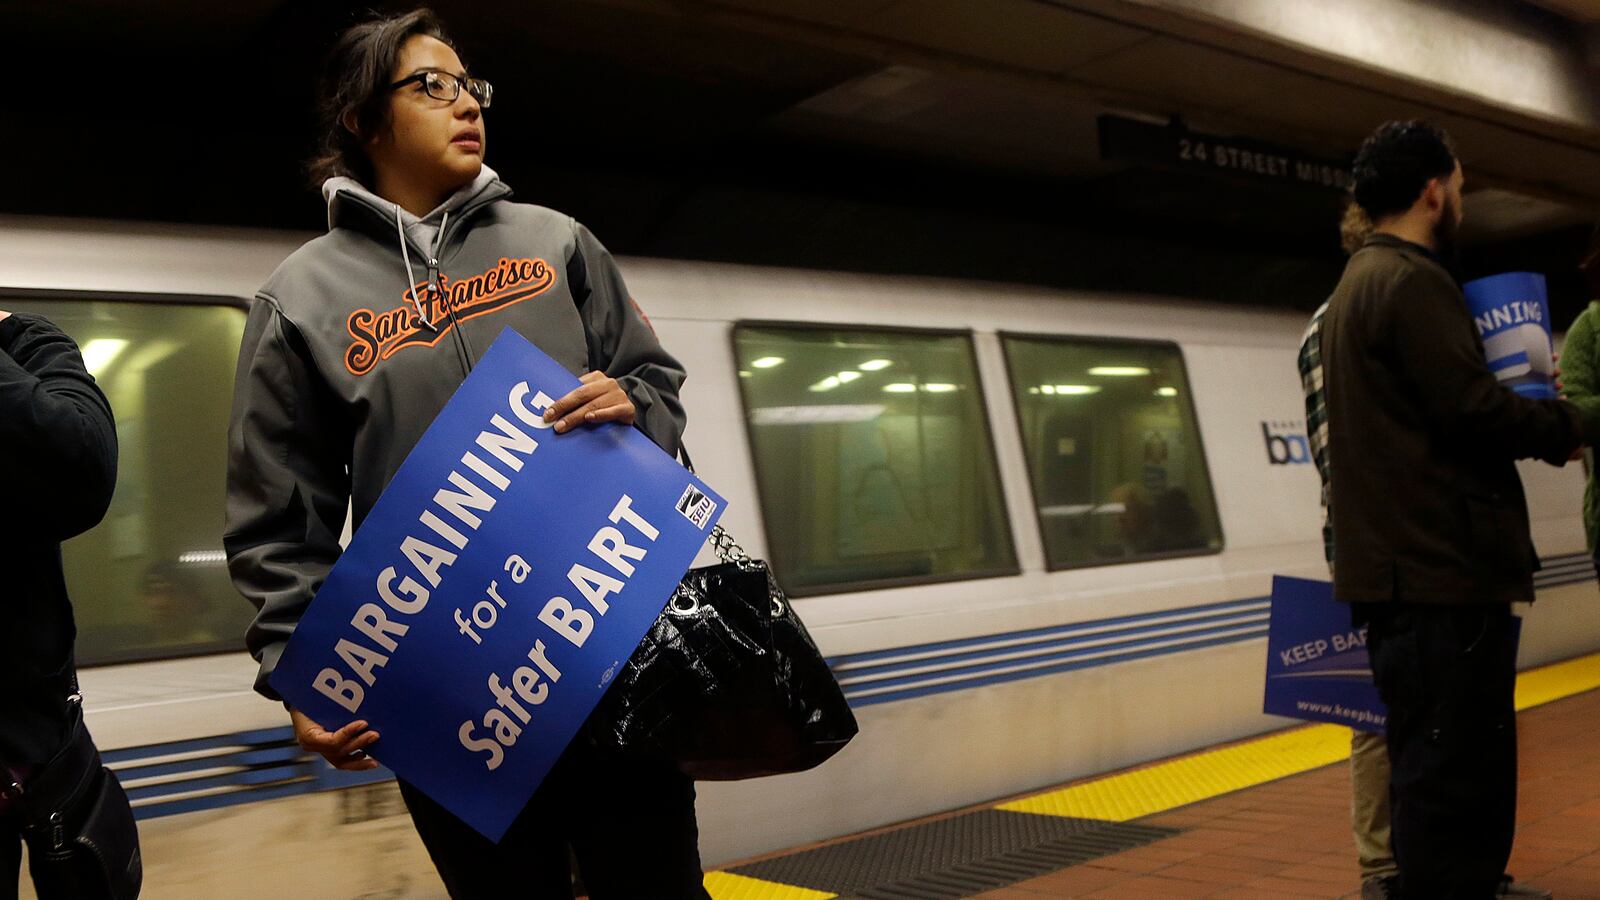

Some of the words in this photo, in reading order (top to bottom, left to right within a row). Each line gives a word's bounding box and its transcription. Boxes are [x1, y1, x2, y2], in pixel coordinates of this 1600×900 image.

[1179, 139, 1207, 161] 24
[1215, 145, 1289, 176] STREET
[345, 308, 411, 375] San
[403, 257, 556, 330] Francisco
[312, 381, 556, 713] BARGAINING
[692, 497, 711, 526] SEIU
[454, 580, 507, 645] for
[503, 555, 532, 584] a
[458, 639, 562, 771] Safer
[537, 494, 660, 648] BART
[1280, 641, 1328, 667] KEEP
